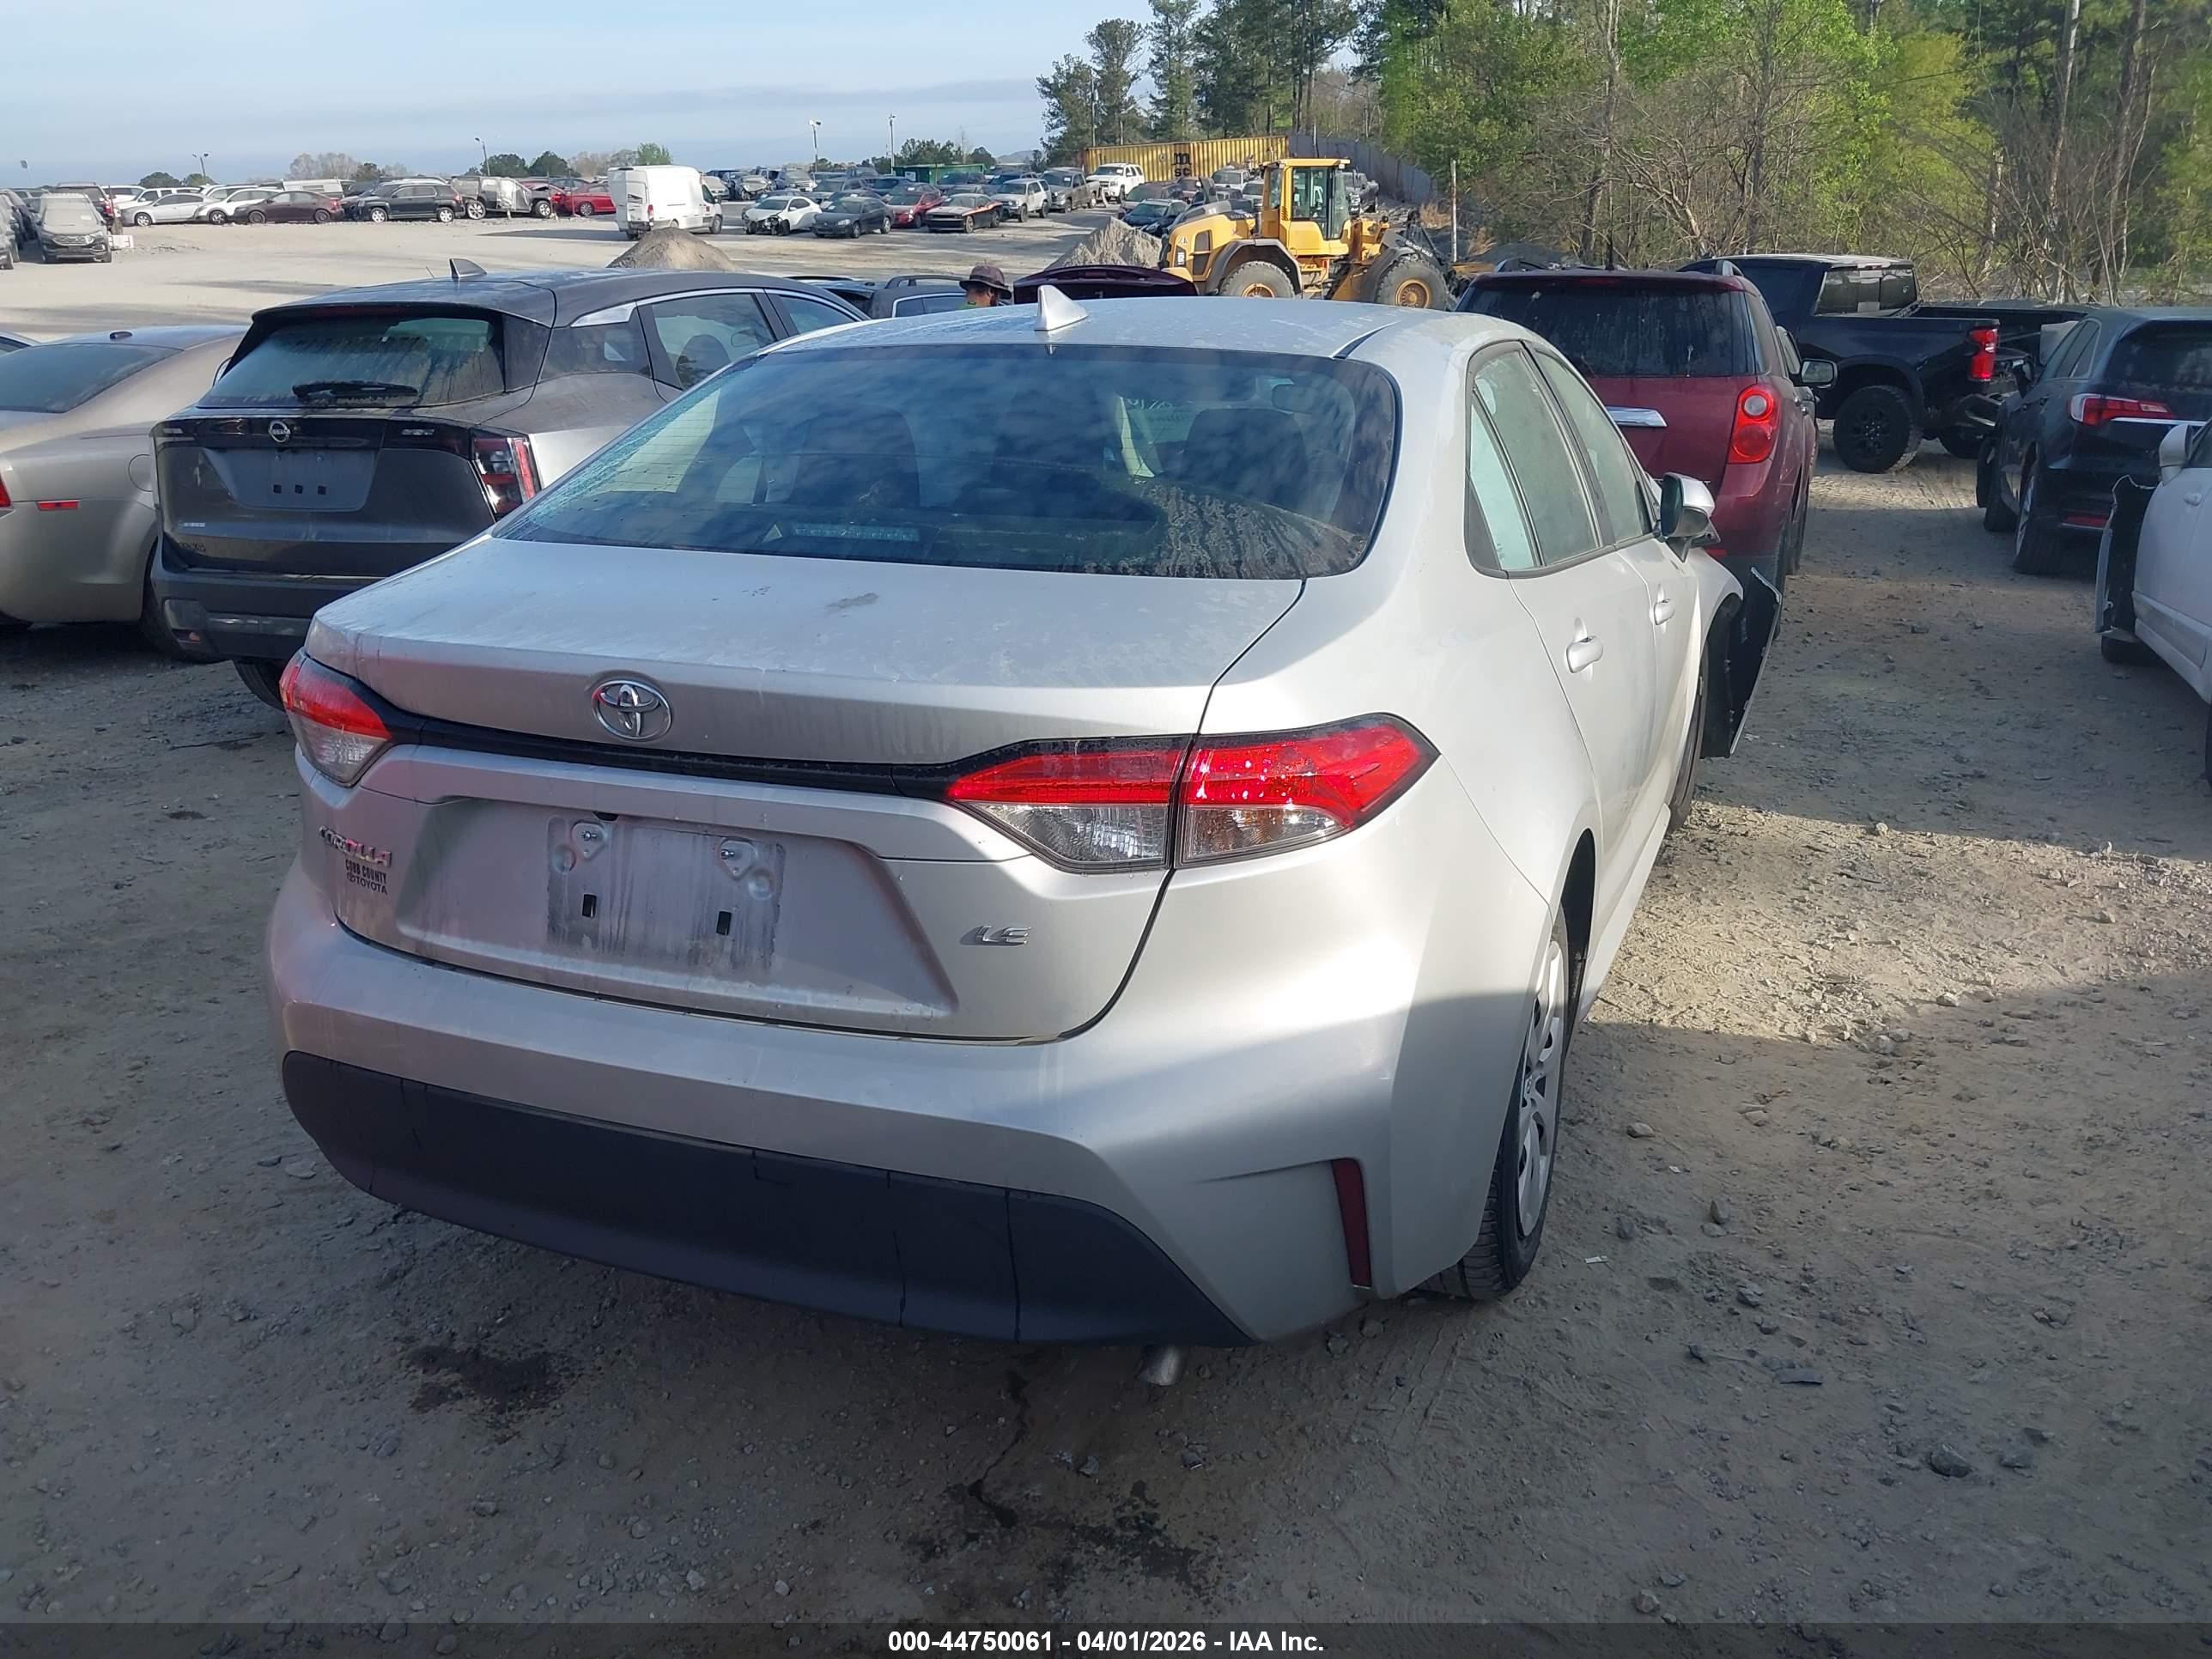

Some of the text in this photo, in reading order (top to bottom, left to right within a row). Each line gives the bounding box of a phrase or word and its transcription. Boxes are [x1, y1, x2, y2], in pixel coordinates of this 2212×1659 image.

[345, 859, 387, 884] COBB COUNTY
[356, 875, 388, 896] TOYOTA
[962, 925, 1030, 945] LE
